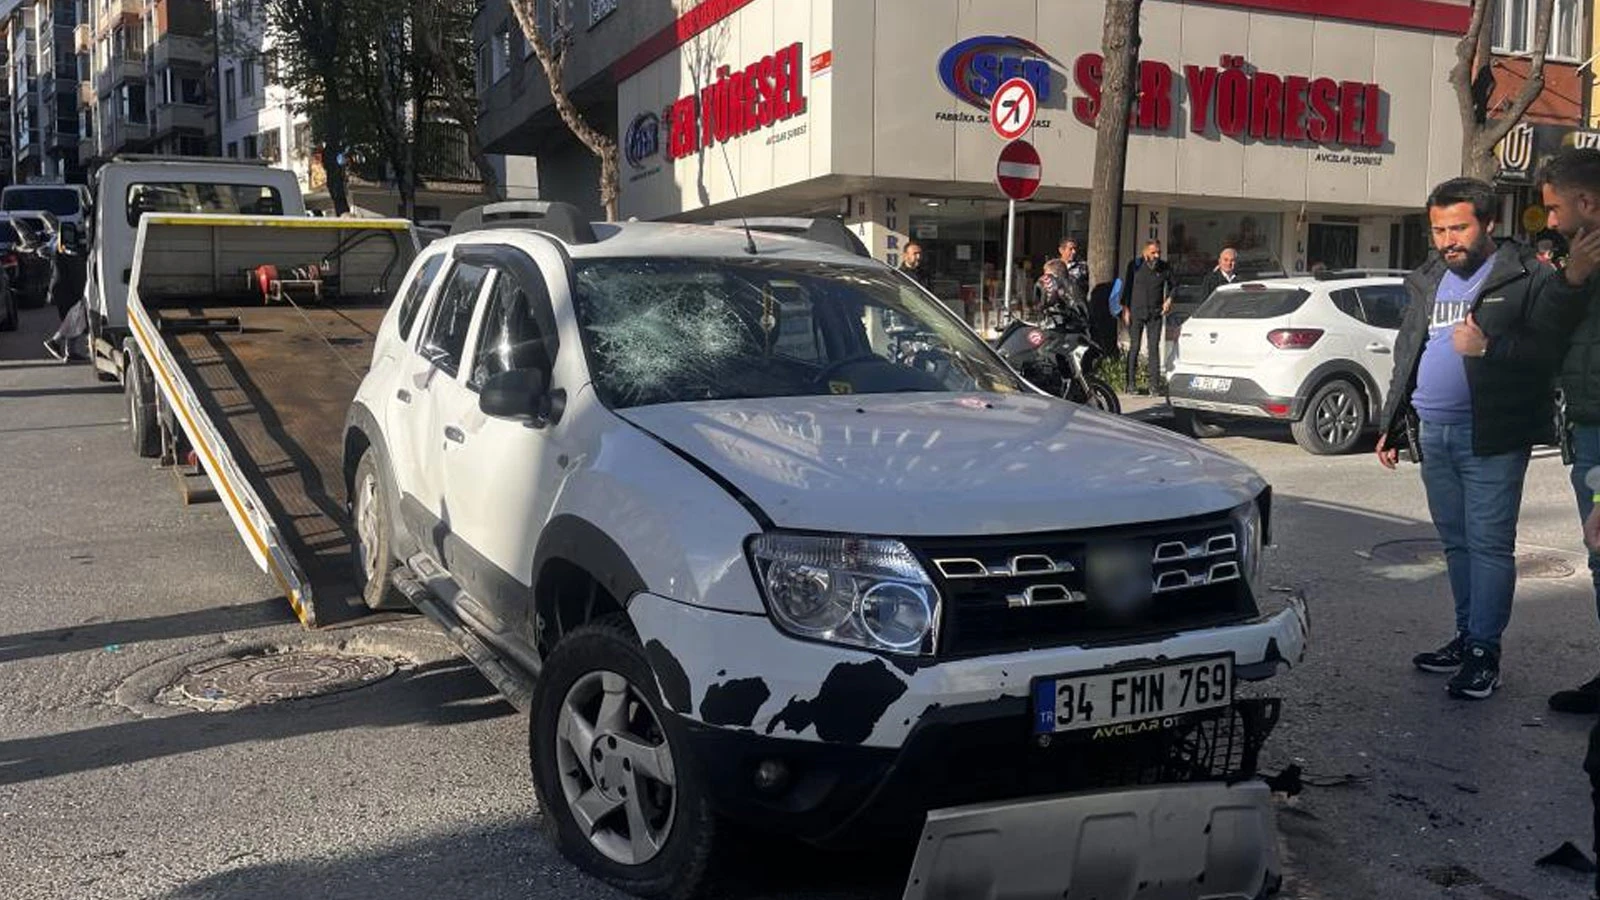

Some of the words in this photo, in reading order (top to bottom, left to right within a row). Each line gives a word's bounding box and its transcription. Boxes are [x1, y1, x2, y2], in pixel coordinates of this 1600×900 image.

[1072, 53, 1173, 129] SR
[1184, 54, 1385, 146] YÖRESEL
[1056, 682, 1095, 726] 34
[1110, 672, 1166, 719] FMN
[1178, 662, 1227, 709] 769
[1092, 719, 1161, 741] AVCILAR
